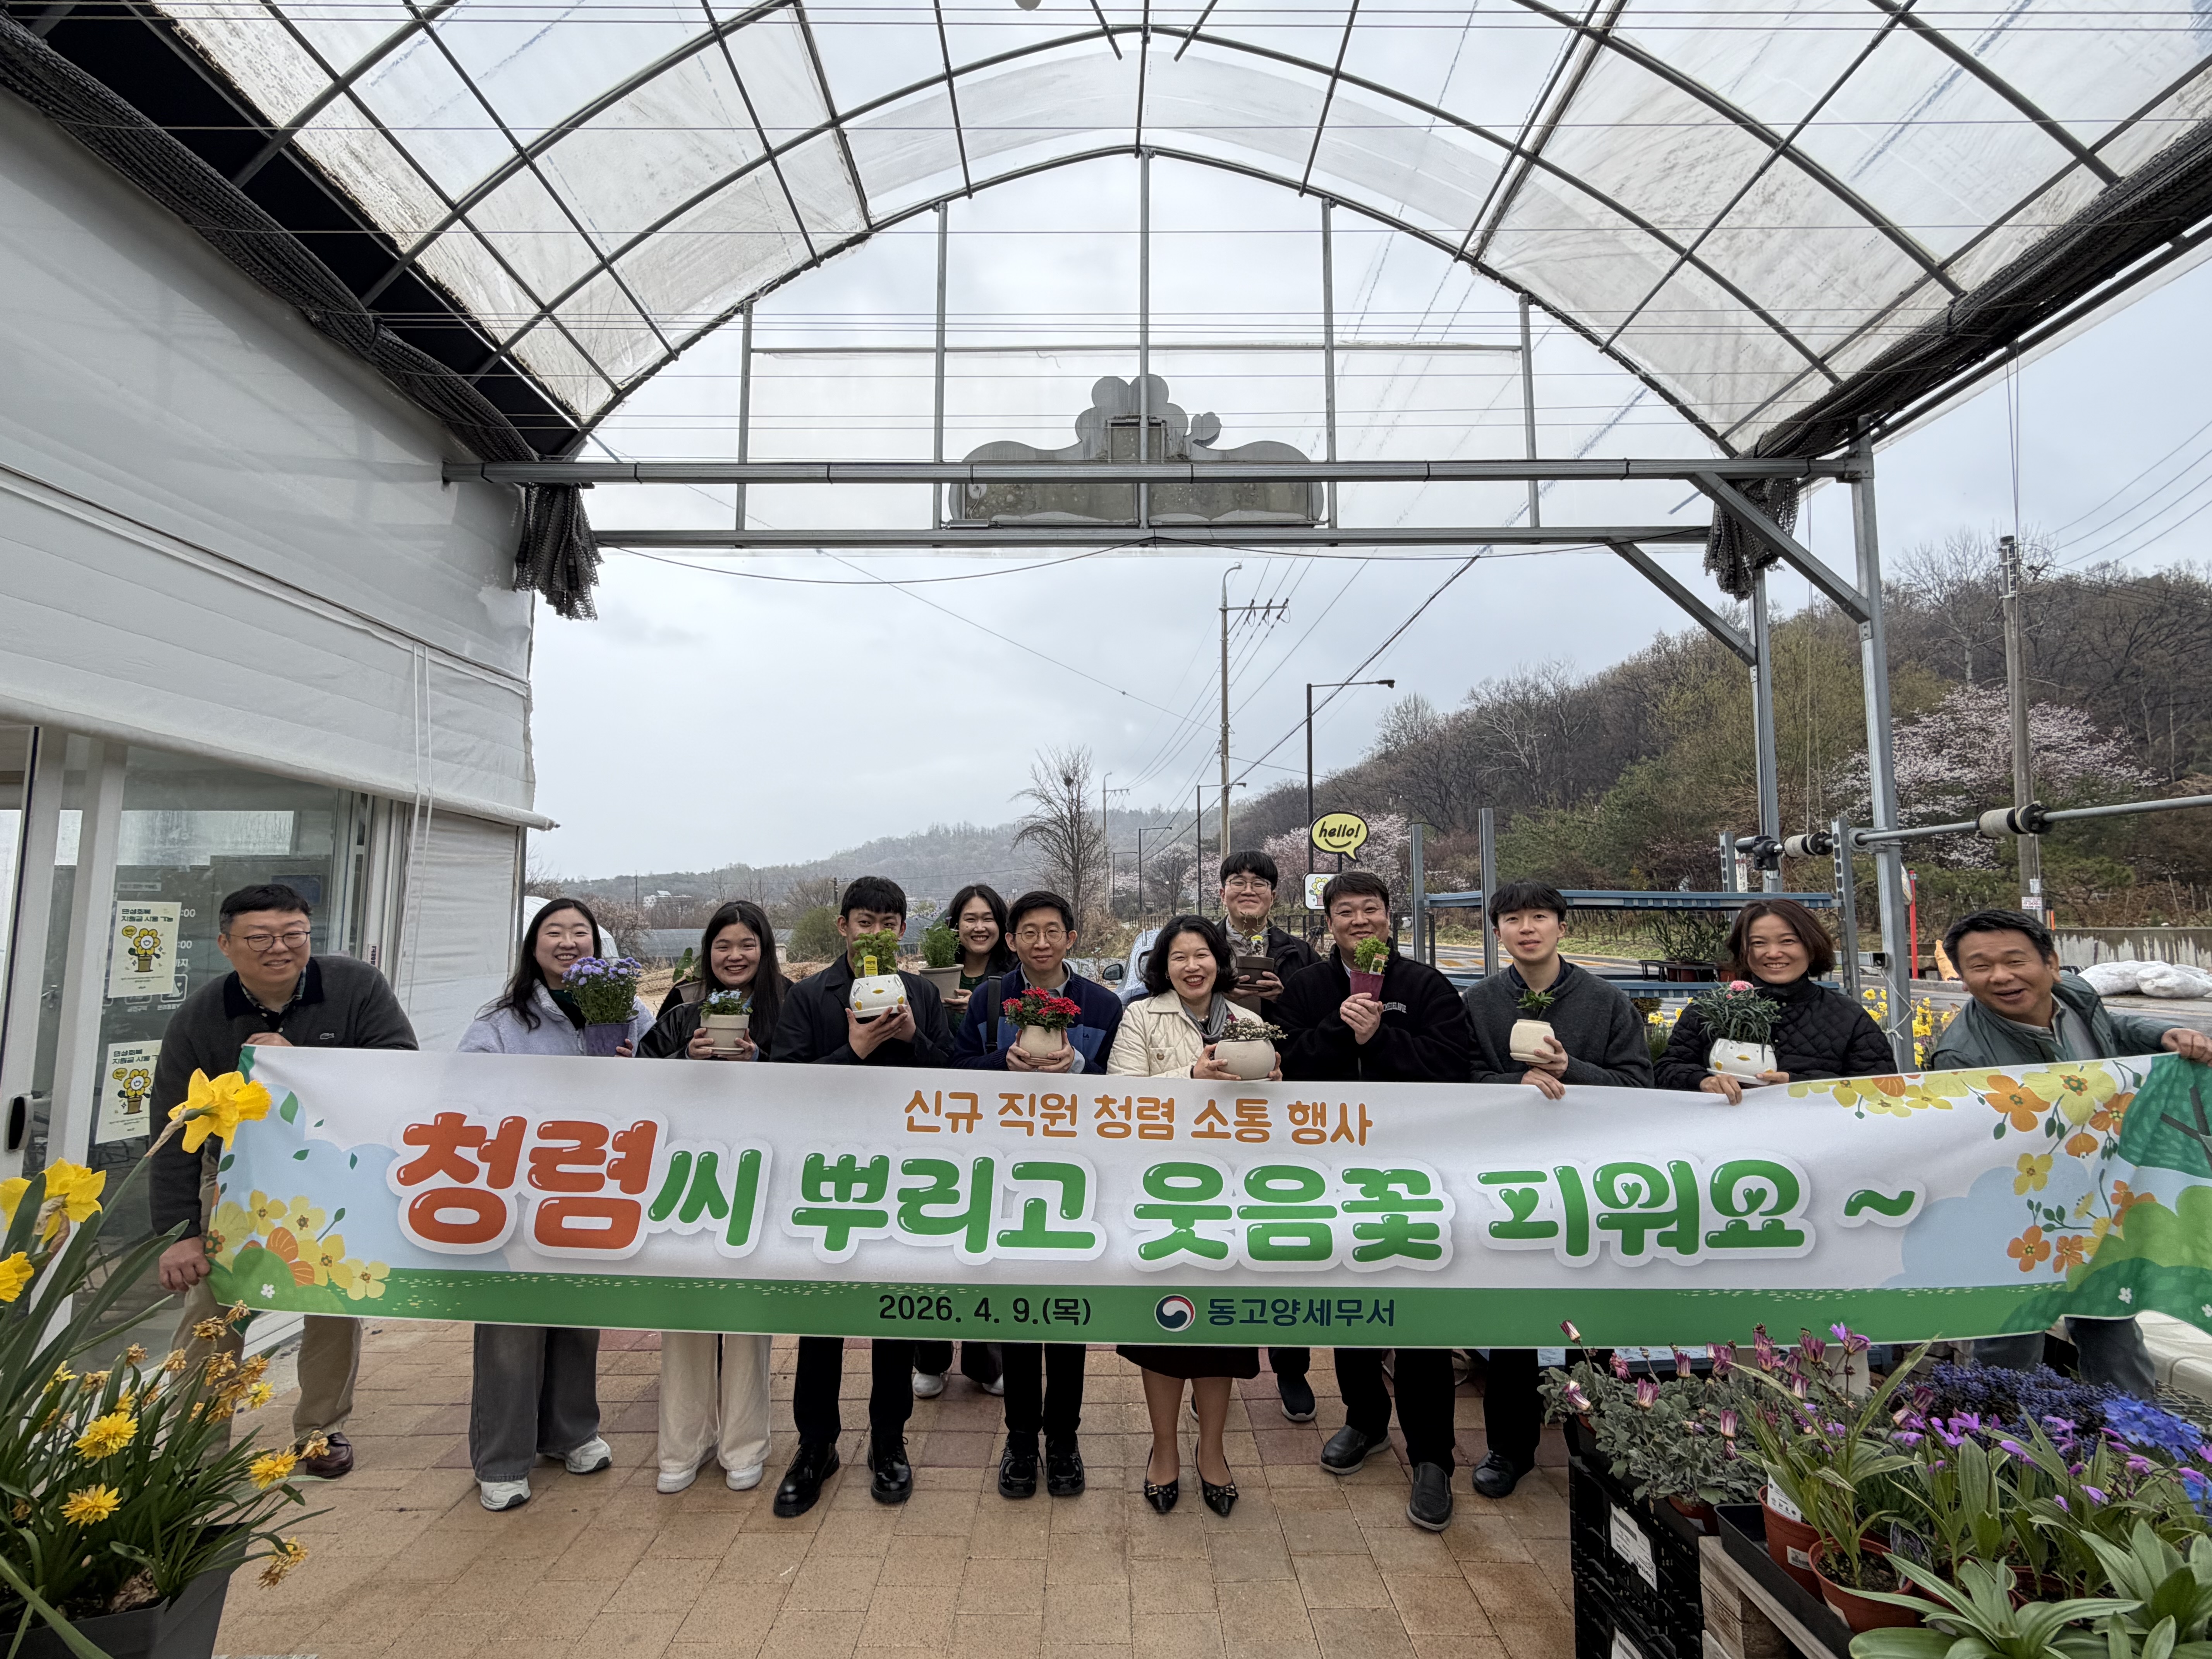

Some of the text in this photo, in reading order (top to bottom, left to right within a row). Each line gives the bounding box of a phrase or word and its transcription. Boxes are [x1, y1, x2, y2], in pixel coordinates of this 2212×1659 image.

[1319, 821, 1361, 838] hello!
[180, 908, 196, 918] :00
[177, 940, 192, 949] :00
[905, 1090, 1373, 1146] 신규 직원 청렴 소통 행사
[397, 1111, 761, 1250] 청렴씨
[791, 1152, 1096, 1253] 뿌리고
[1133, 1162, 1444, 1262] 웃음꽃
[1477, 1159, 1805, 1257] 피워요
[879, 1295, 1091, 1326] 2026. 4. 9.(목)
[1207, 1298, 1395, 1327] 동고양세무서
